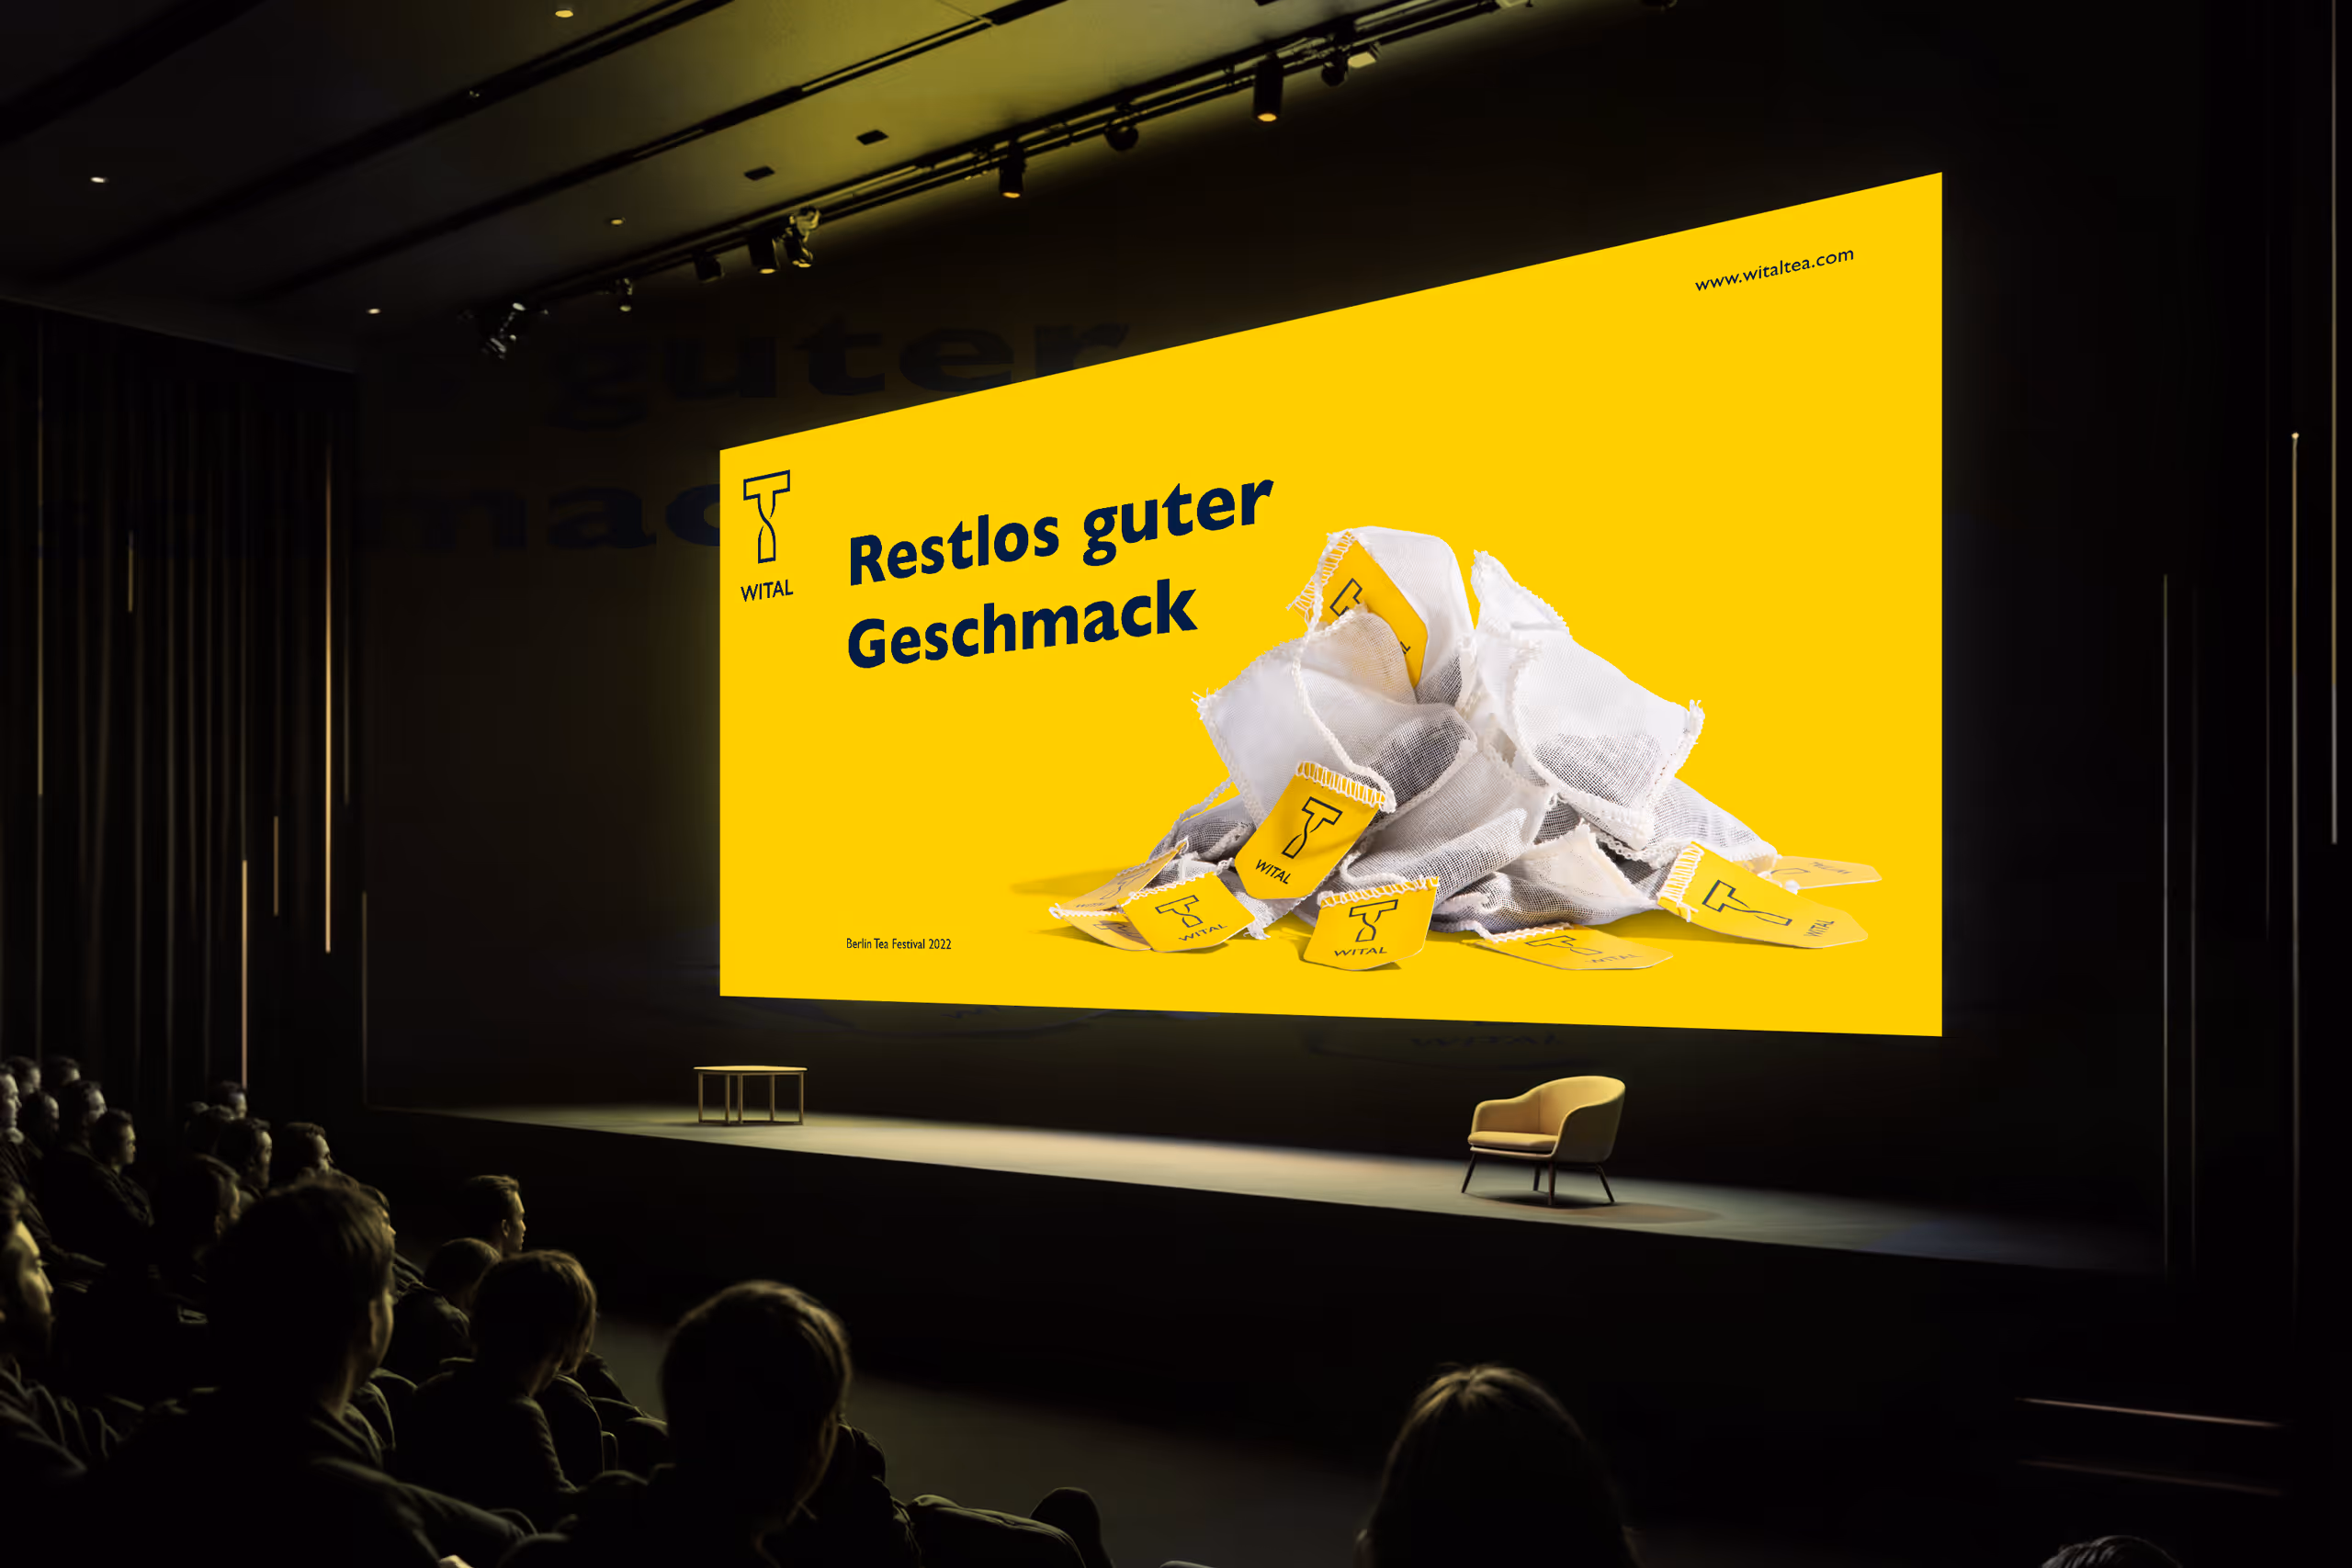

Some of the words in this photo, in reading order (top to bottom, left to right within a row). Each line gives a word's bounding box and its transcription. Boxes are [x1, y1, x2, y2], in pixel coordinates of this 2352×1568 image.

[1695, 250, 1854, 291] www.witaltea.com
[850, 514, 1059, 586] Restlos
[1082, 479, 1274, 566] guter
[741, 579, 794, 603] WITAL
[848, 578, 1198, 669] Geschmack
[1255, 859, 1292, 885] WITAL
[846, 937, 872, 949] Berlin
[873, 937, 889, 949] Tea
[892, 938, 925, 949] Festival
[928, 938, 952, 950] 2022
[1178, 923, 1228, 942] WITAL
[1334, 946, 1387, 957] WITAL
